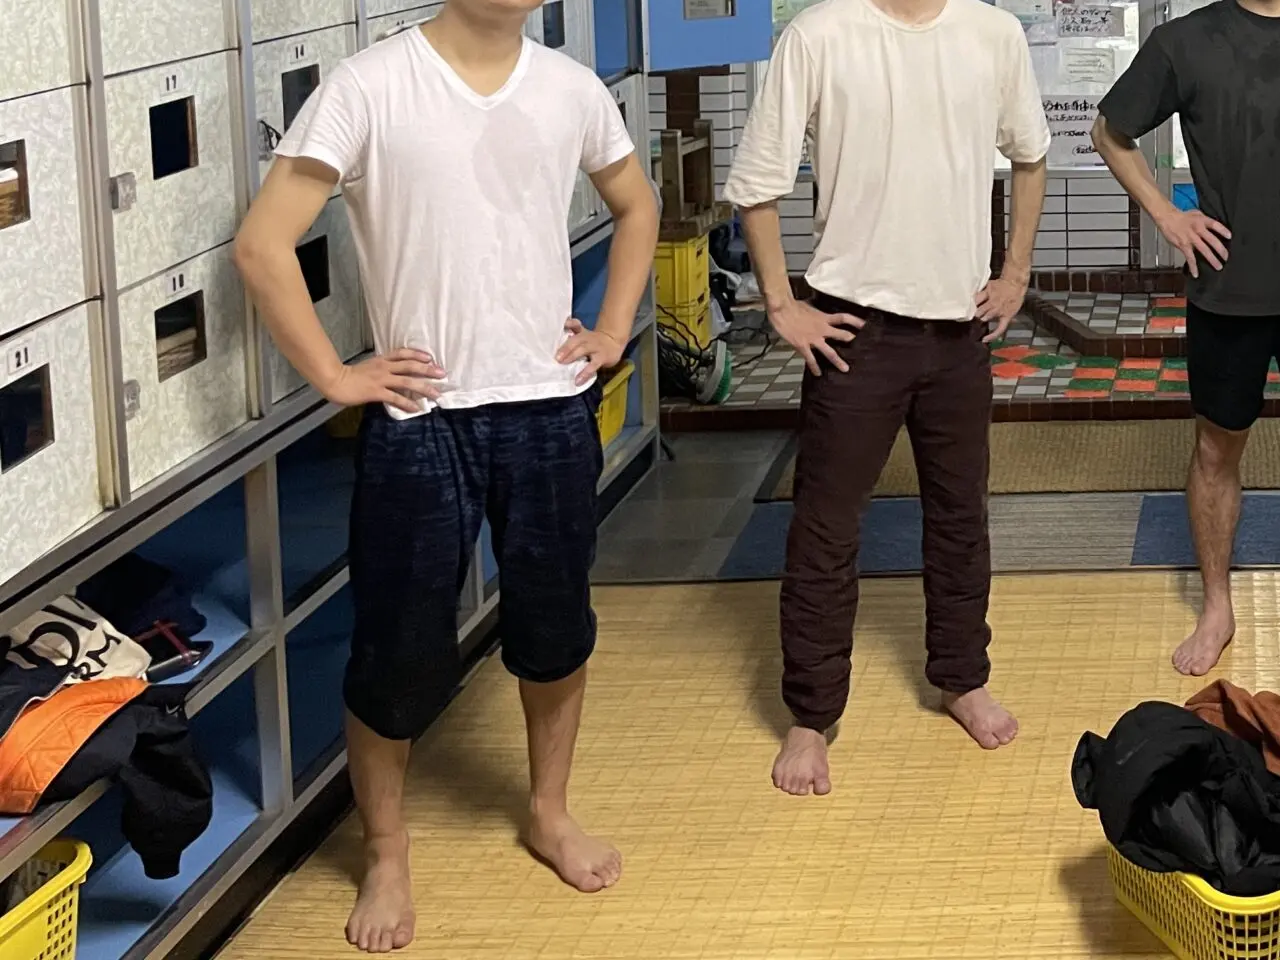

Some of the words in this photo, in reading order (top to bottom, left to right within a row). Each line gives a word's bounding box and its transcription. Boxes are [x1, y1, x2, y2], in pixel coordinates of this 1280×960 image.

[295, 44, 305, 59] 14
[165, 74, 177, 91] 17
[15, 346, 29, 368] 21
